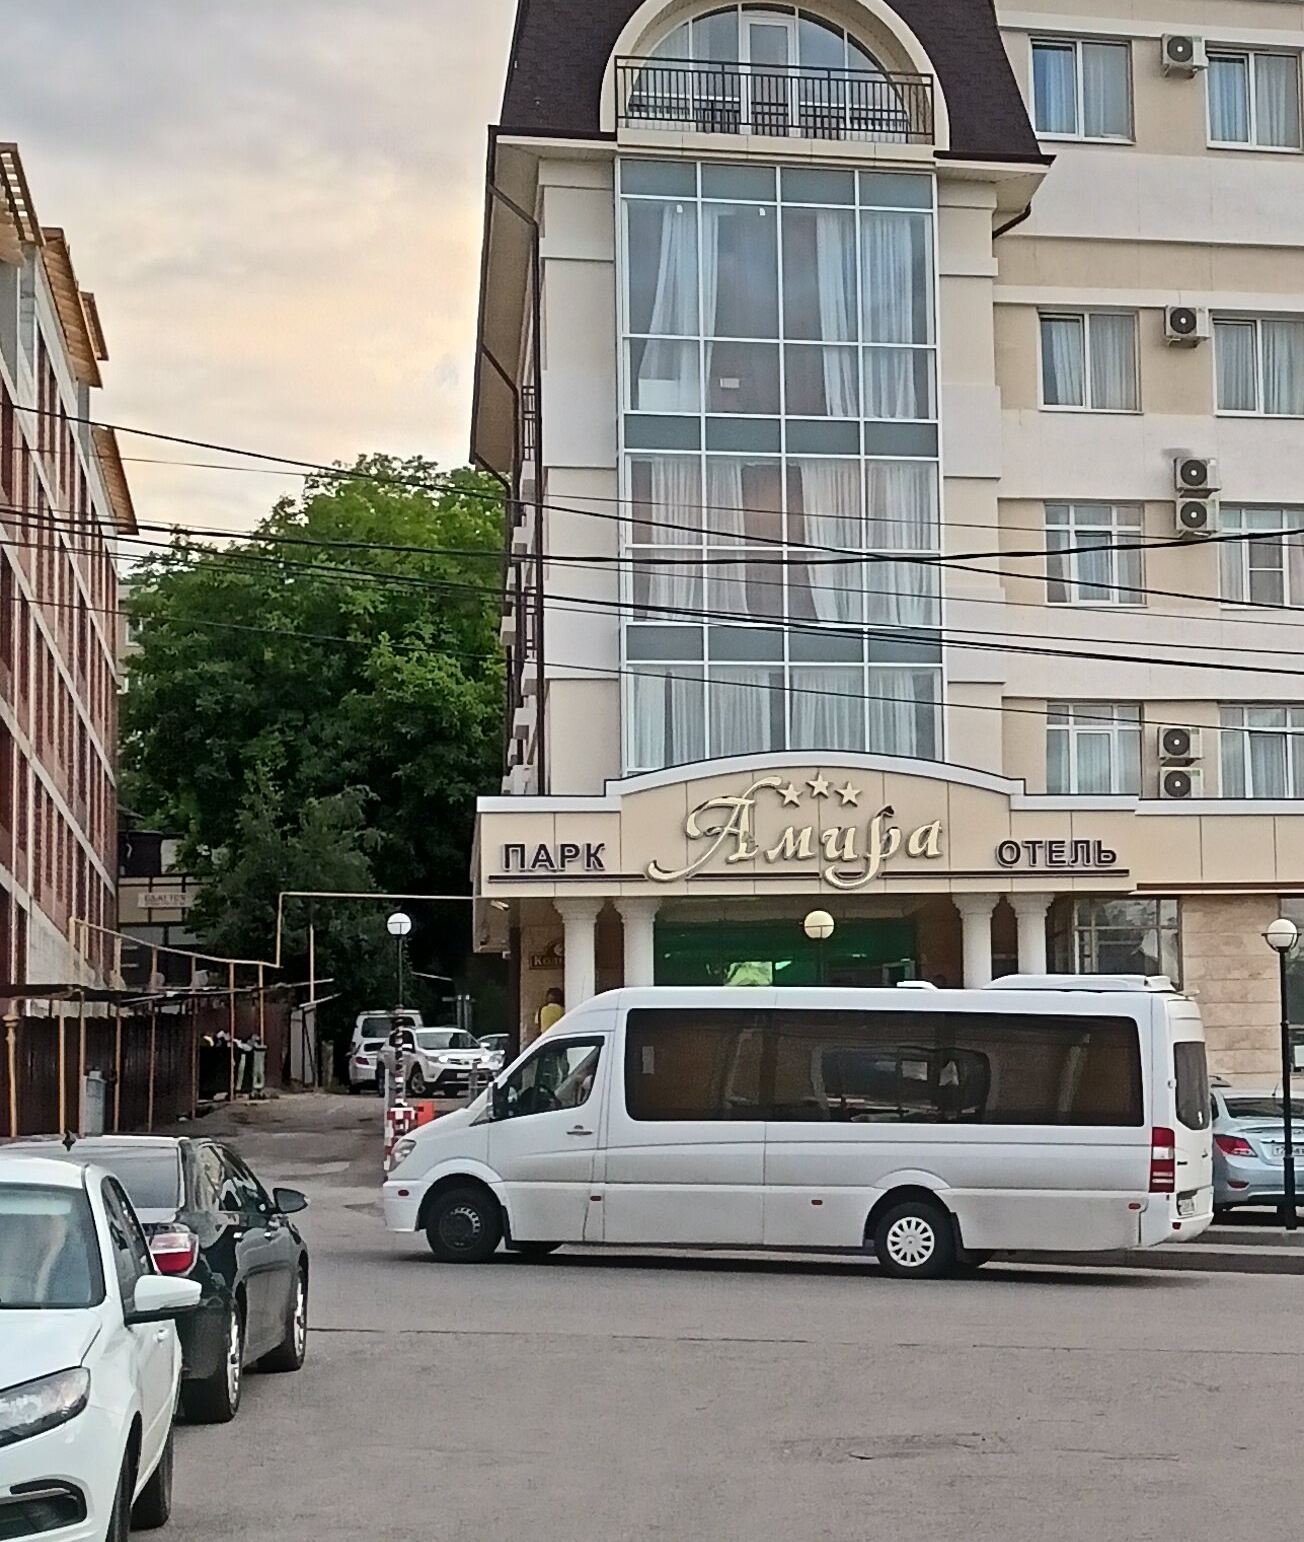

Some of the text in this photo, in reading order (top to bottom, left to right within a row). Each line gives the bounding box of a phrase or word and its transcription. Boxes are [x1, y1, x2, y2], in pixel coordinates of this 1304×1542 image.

[502, 776, 1117, 890] ПАРК Амира ОТЕЛЬ
